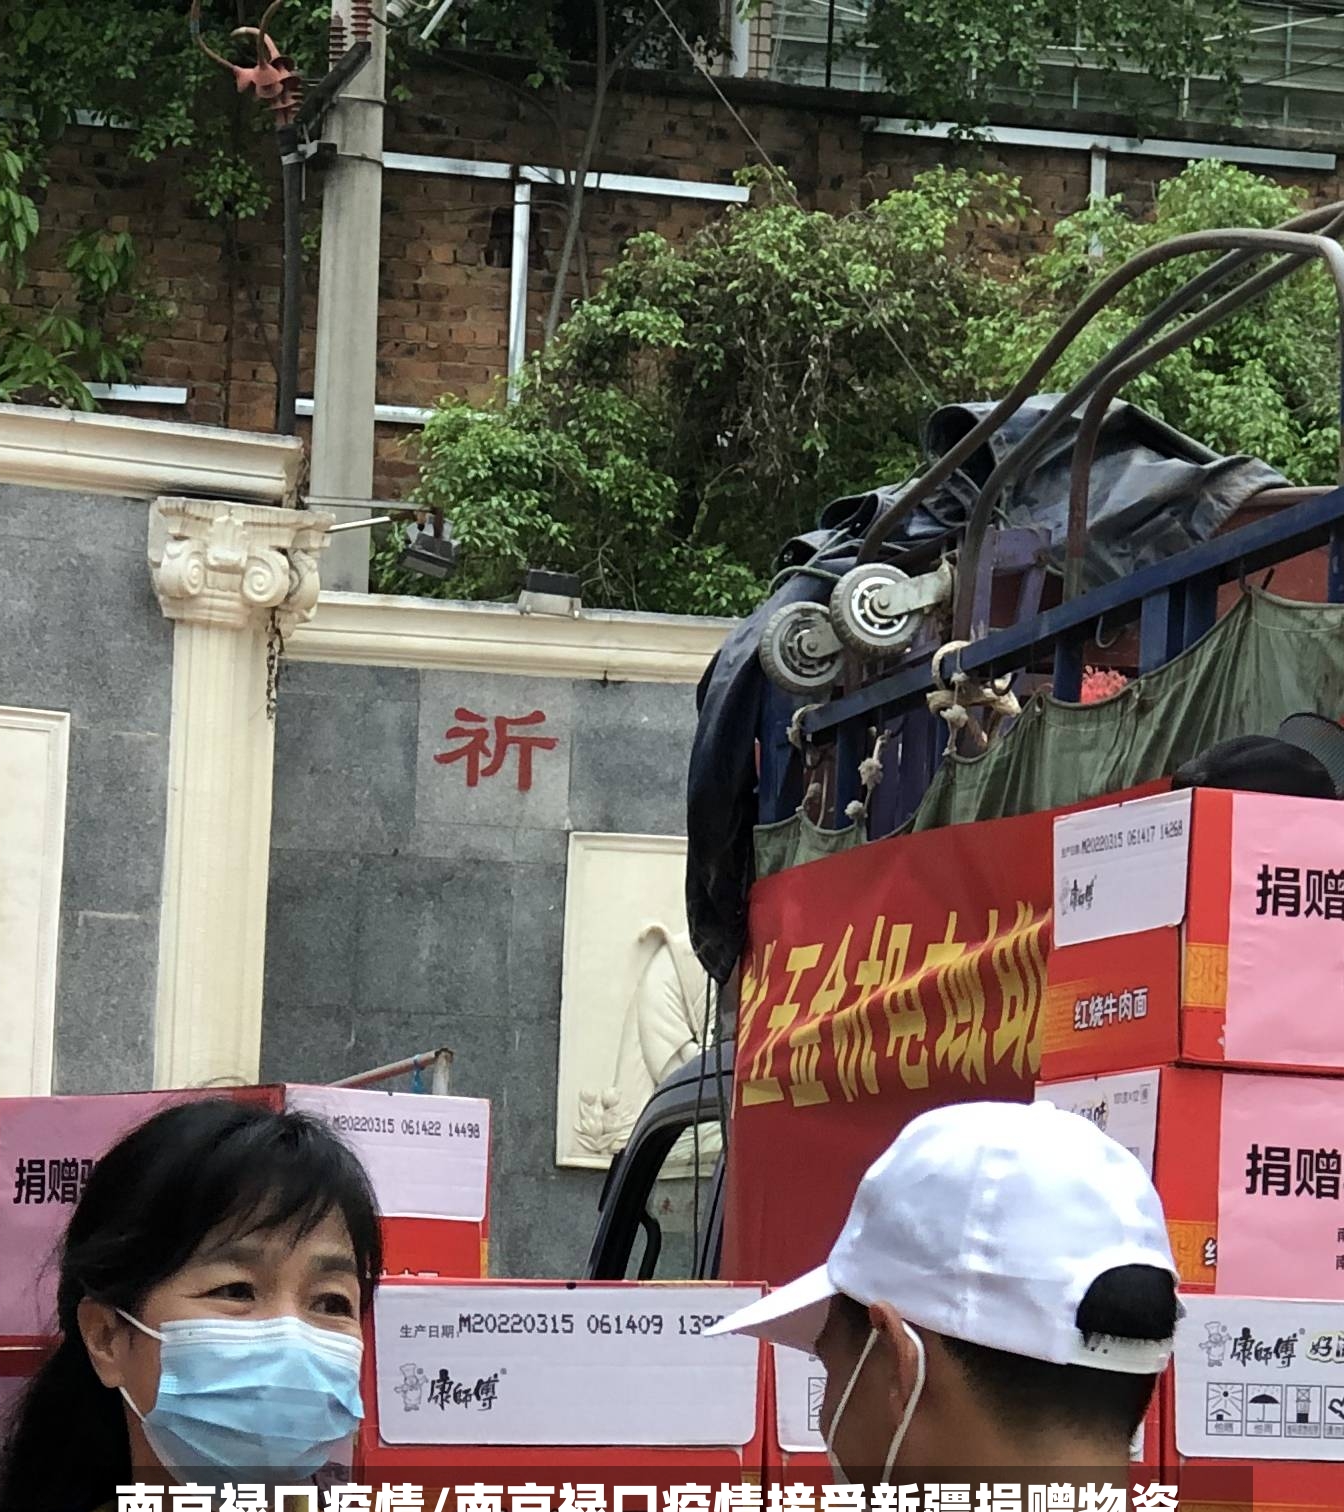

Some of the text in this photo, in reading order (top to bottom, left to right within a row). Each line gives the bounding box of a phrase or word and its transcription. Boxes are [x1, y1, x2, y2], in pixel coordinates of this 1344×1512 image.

[434, 706, 560, 794] 祈
[1073, 988, 1149, 1030] 红烧牛肉面
[401, 1120, 443, 1137] 061422
[459, 1314, 574, 1335] M20220315
[587, 1315, 663, 1335] 061409
[427, 1369, 500, 1411] 康師傅
